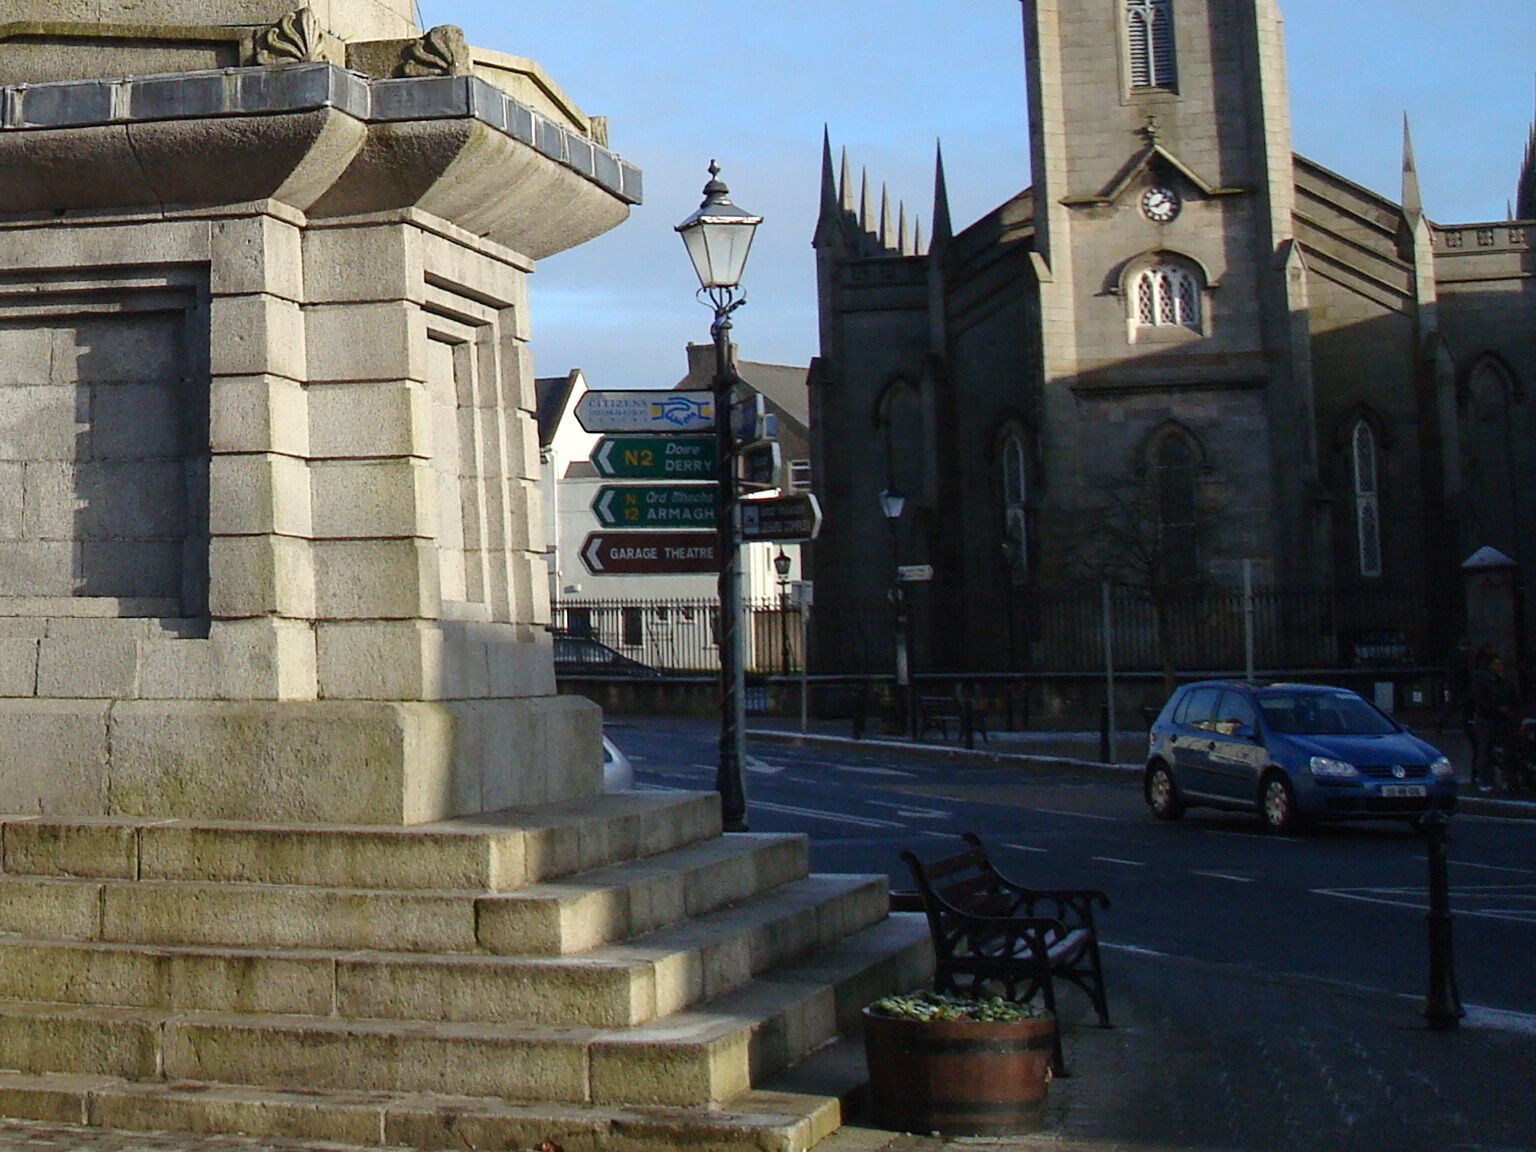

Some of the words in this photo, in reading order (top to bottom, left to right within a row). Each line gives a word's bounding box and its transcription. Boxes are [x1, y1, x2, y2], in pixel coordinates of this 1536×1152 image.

[624, 450, 654, 466] N2
[665, 460, 713, 472] DERRY
[646, 508, 715, 520] ARMAGH
[610, 547, 658, 560] GARAGE
[665, 547, 714, 560] THEATRE
